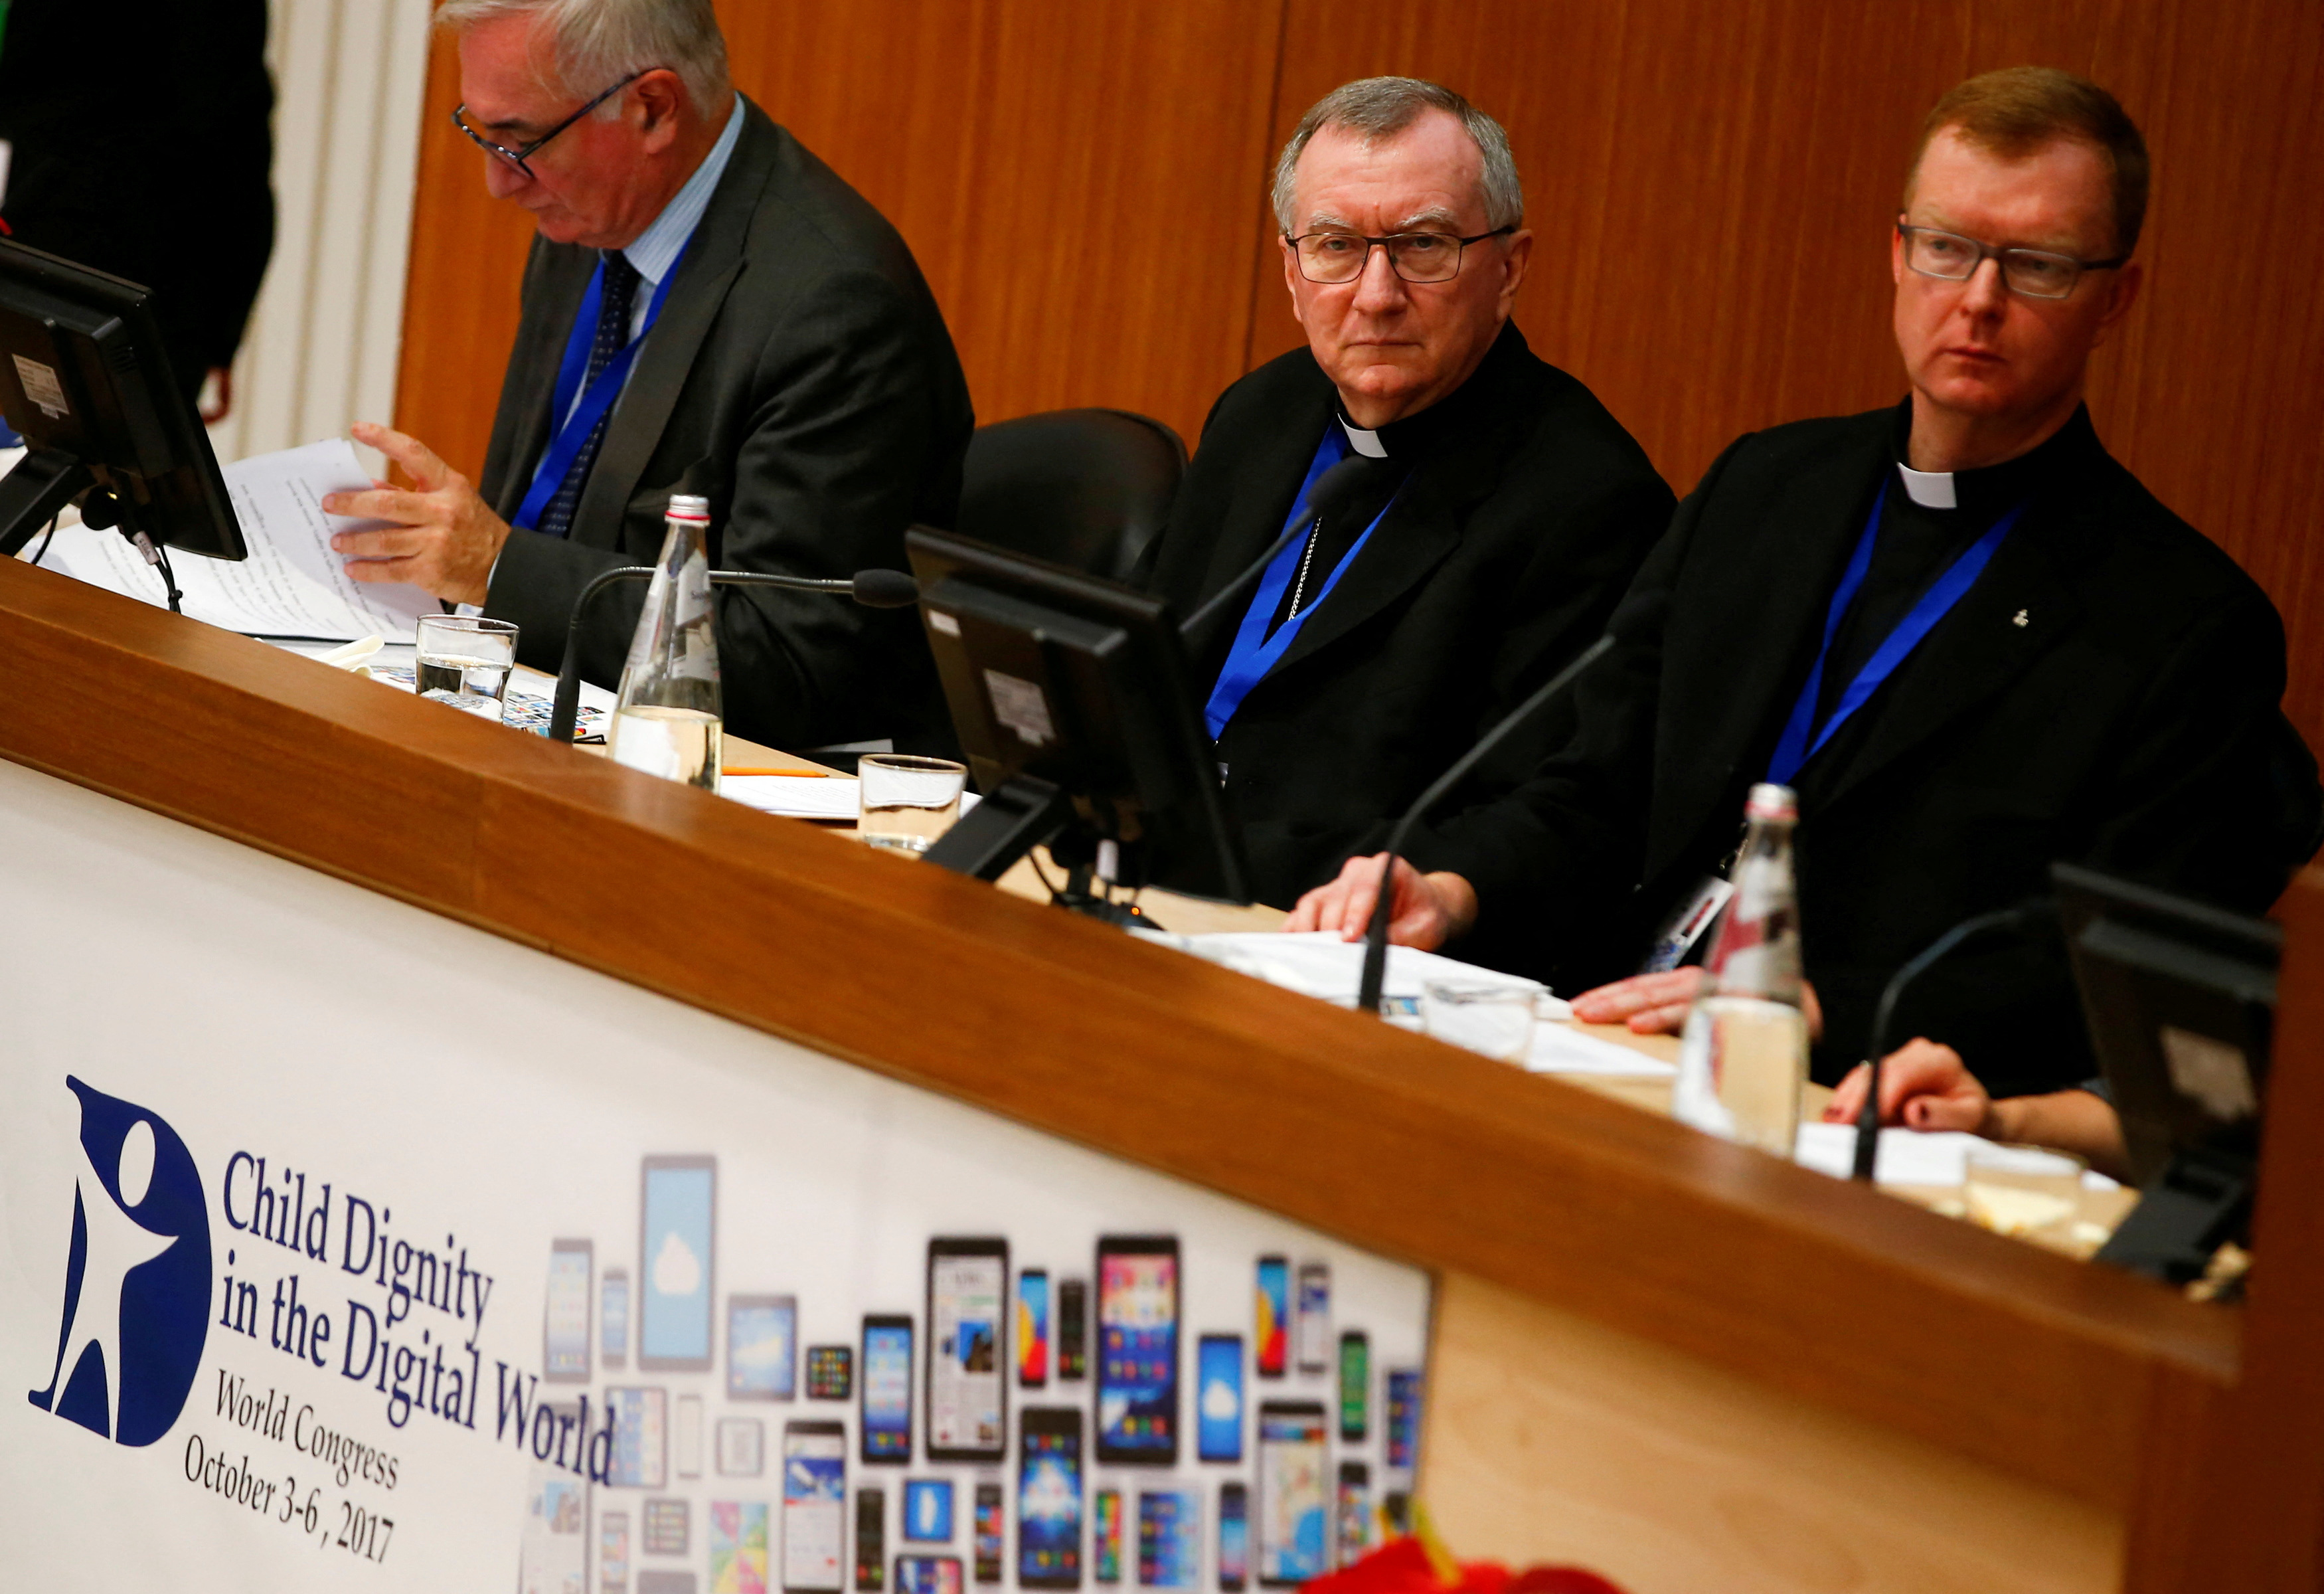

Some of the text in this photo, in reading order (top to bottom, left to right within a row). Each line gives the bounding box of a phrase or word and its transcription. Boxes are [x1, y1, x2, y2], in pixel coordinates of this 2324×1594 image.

[224, 1151, 493, 1350] Child Dignity
[216, 1369, 399, 1490] World Congress
[219, 1249, 616, 1488] in the Digital World
[185, 1435, 277, 1514] October
[337, 1500, 394, 1563] 2017
